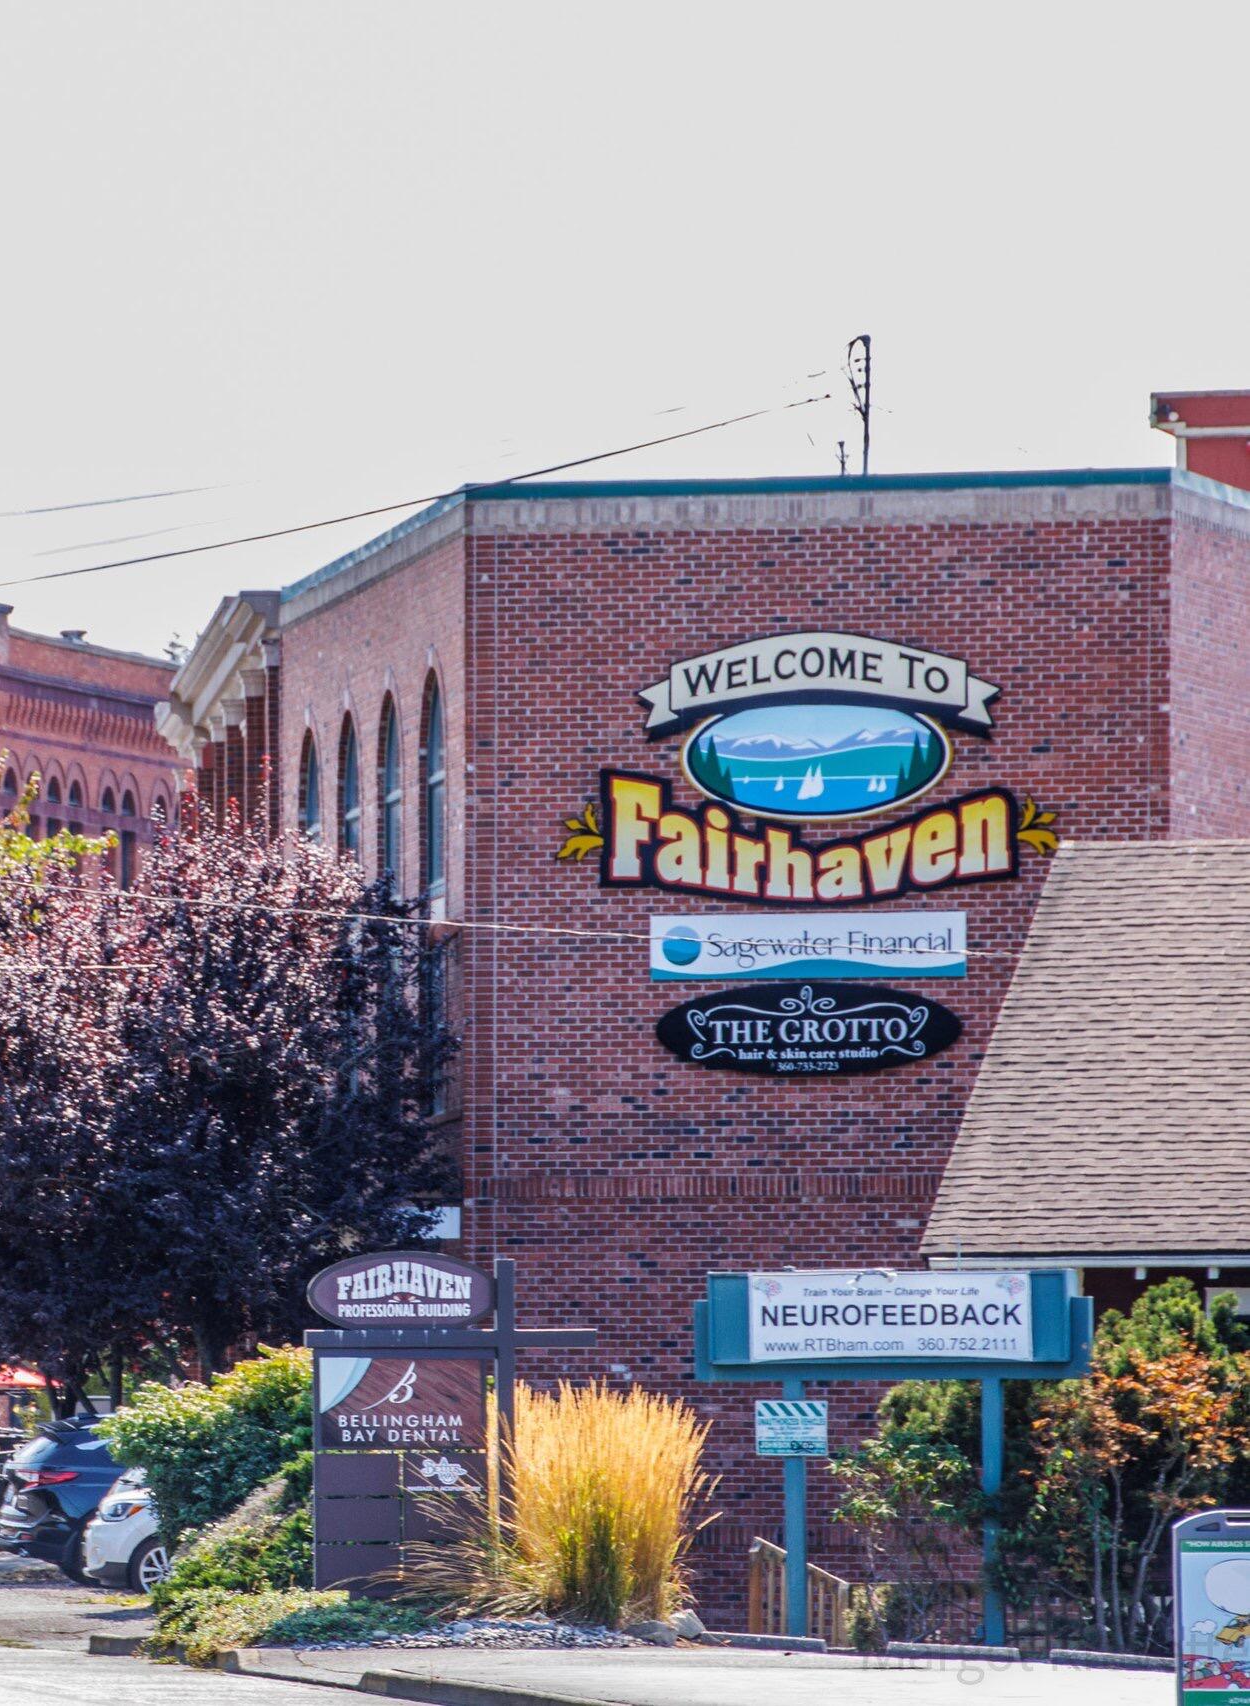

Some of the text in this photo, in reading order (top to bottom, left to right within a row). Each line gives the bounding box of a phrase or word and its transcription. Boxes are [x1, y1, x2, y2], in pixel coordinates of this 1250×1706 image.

[683, 647, 882, 697] WELCOME
[610, 774, 1012, 903] Fairhaven
[706, 928, 953, 969] Sagewater Financial
[708, 1017, 908, 1044] THE GROTTO
[737, 1047, 879, 1060] hair & skin care studio
[336, 1261, 472, 1300] FAIRHAVEN
[802, 1287, 828, 1298] Train
[831, 1287, 855, 1298] Your
[856, 1287, 883, 1298] Brain
[893, 1286, 933, 1299] Change
[935, 1286, 958, 1297] Your
[960, 1286, 980, 1297] Life
[337, 1303, 472, 1318] PROFESSIONAL BUILDING
[760, 1302, 1023, 1327] NEUROFEEDBACK
[763, 1337, 1018, 1353] www.RTBham.com 360.752.2111
[337, 1414, 464, 1428] BELLINGHAM
[341, 1429, 461, 1442] BAY DENTAL
